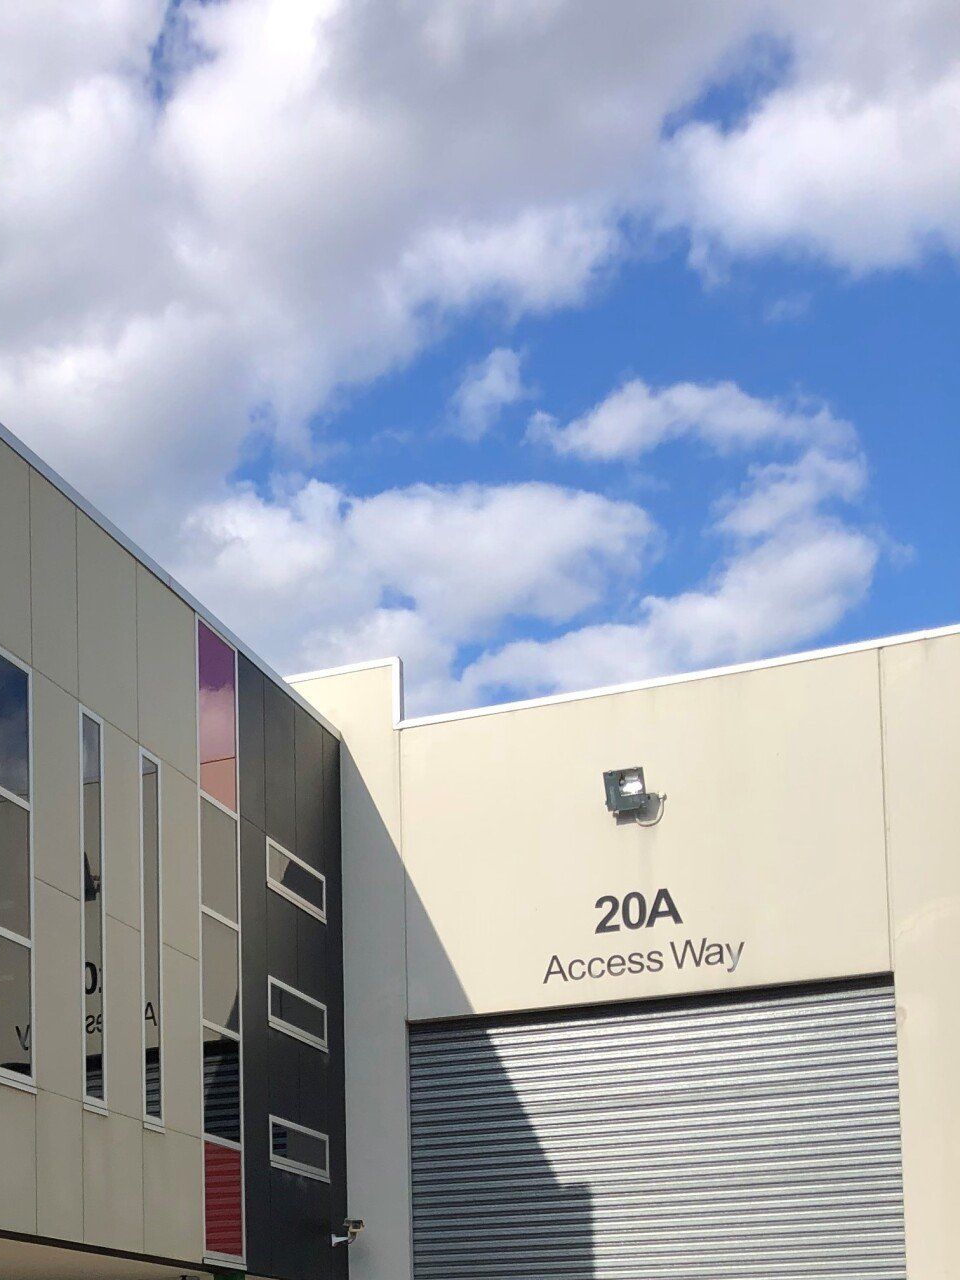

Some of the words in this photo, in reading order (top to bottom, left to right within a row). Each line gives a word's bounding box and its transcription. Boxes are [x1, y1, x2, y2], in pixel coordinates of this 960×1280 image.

[595, 888, 683, 934] 20A
[543, 950, 664, 984] Access
[669, 937, 745, 972] Way
